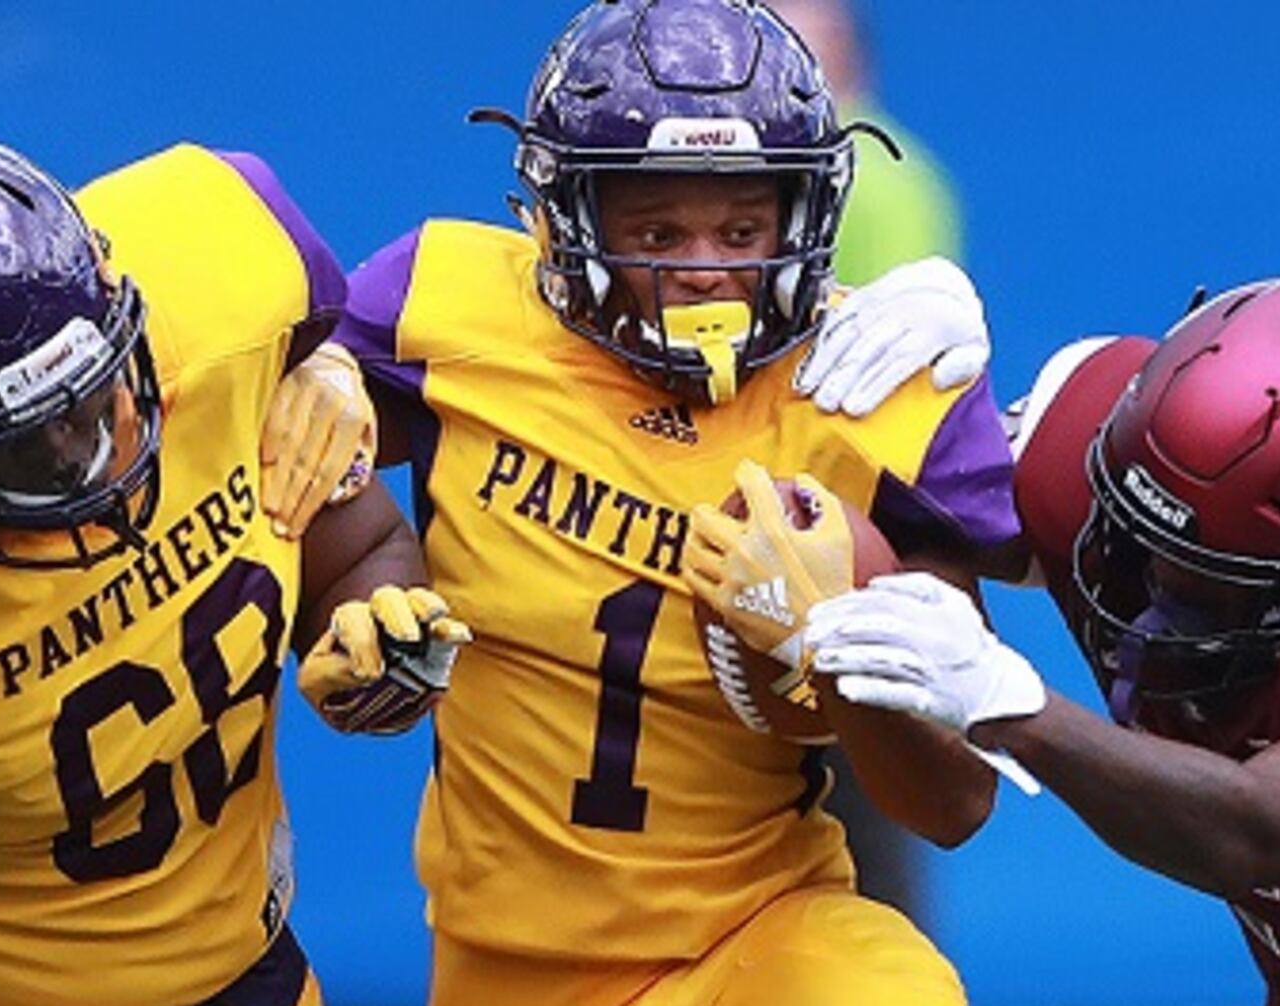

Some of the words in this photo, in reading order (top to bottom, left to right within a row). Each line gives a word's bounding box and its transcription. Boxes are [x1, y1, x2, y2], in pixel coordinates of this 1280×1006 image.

[476, 439, 690, 577] PANTH
[1123, 467, 1189, 530] Riddell
[50, 557, 286, 886] 68
[569, 576, 667, 833] 1
